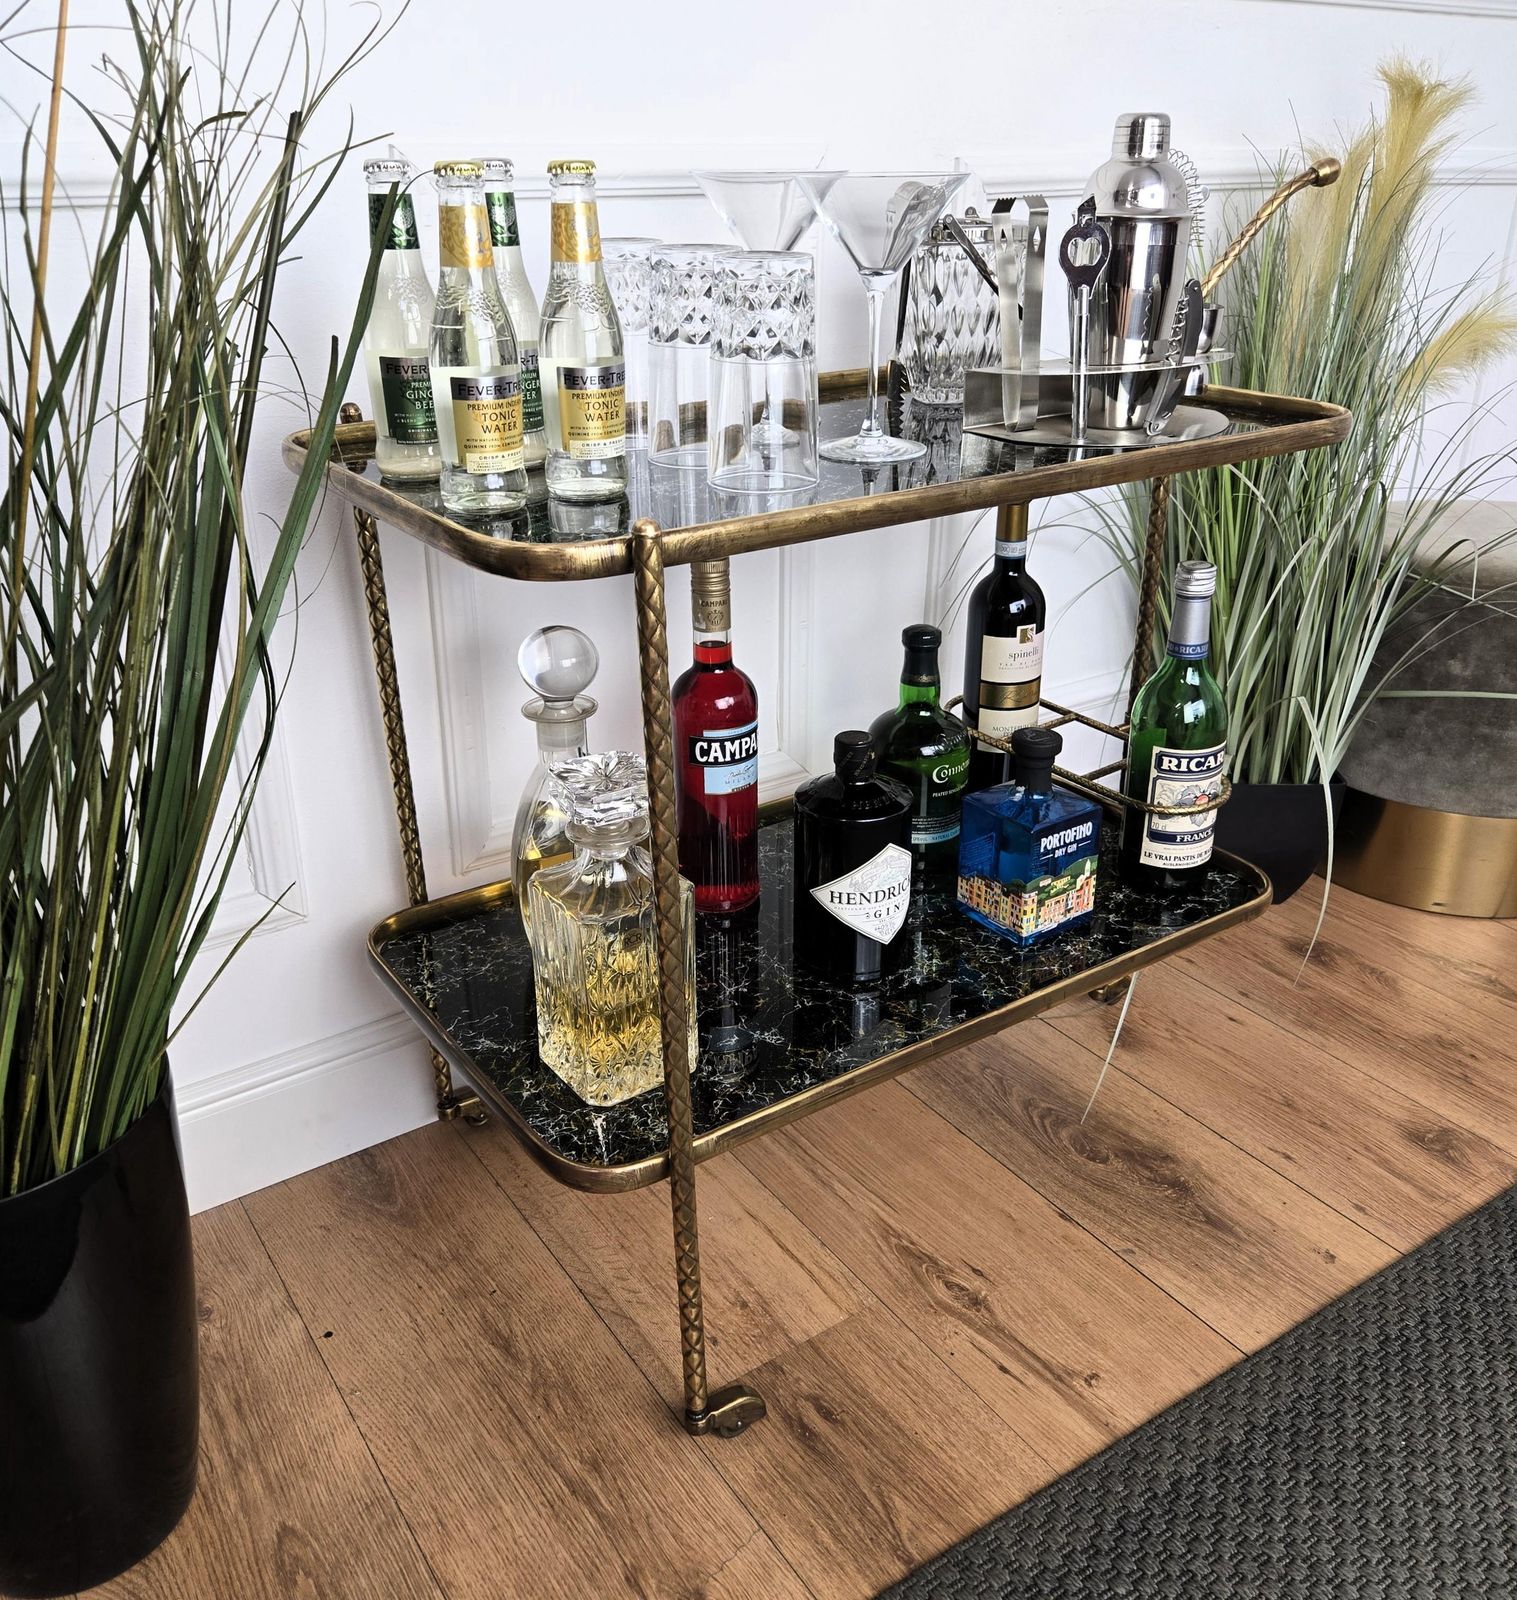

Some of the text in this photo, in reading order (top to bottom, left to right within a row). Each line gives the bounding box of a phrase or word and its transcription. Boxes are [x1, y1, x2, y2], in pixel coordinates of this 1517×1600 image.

[572, 392, 606, 400] PREMIUM
[415, 401, 434, 410] BEE
[467, 401, 504, 411] PREMIUM
[585, 399, 618, 411] TONIC
[482, 409, 516, 422] TONIC
[585, 410, 620, 422] WATER
[481, 421, 518, 434] WATER
[1008, 647, 1039, 661] spinelli
[695, 732, 757, 763] CAMPA
[1161, 750, 1225, 772] RICAR
[1040, 821, 1093, 853] PORTOFINO
[1054, 843, 1078, 858] DRY GIN
[1144, 851, 1153, 859] LE
[1154, 853, 1172, 862] VRAI
[1173, 854, 1196, 862] PASTIS
[829, 875, 910, 906] HENDRIC
[873, 903, 900, 919] GIN
